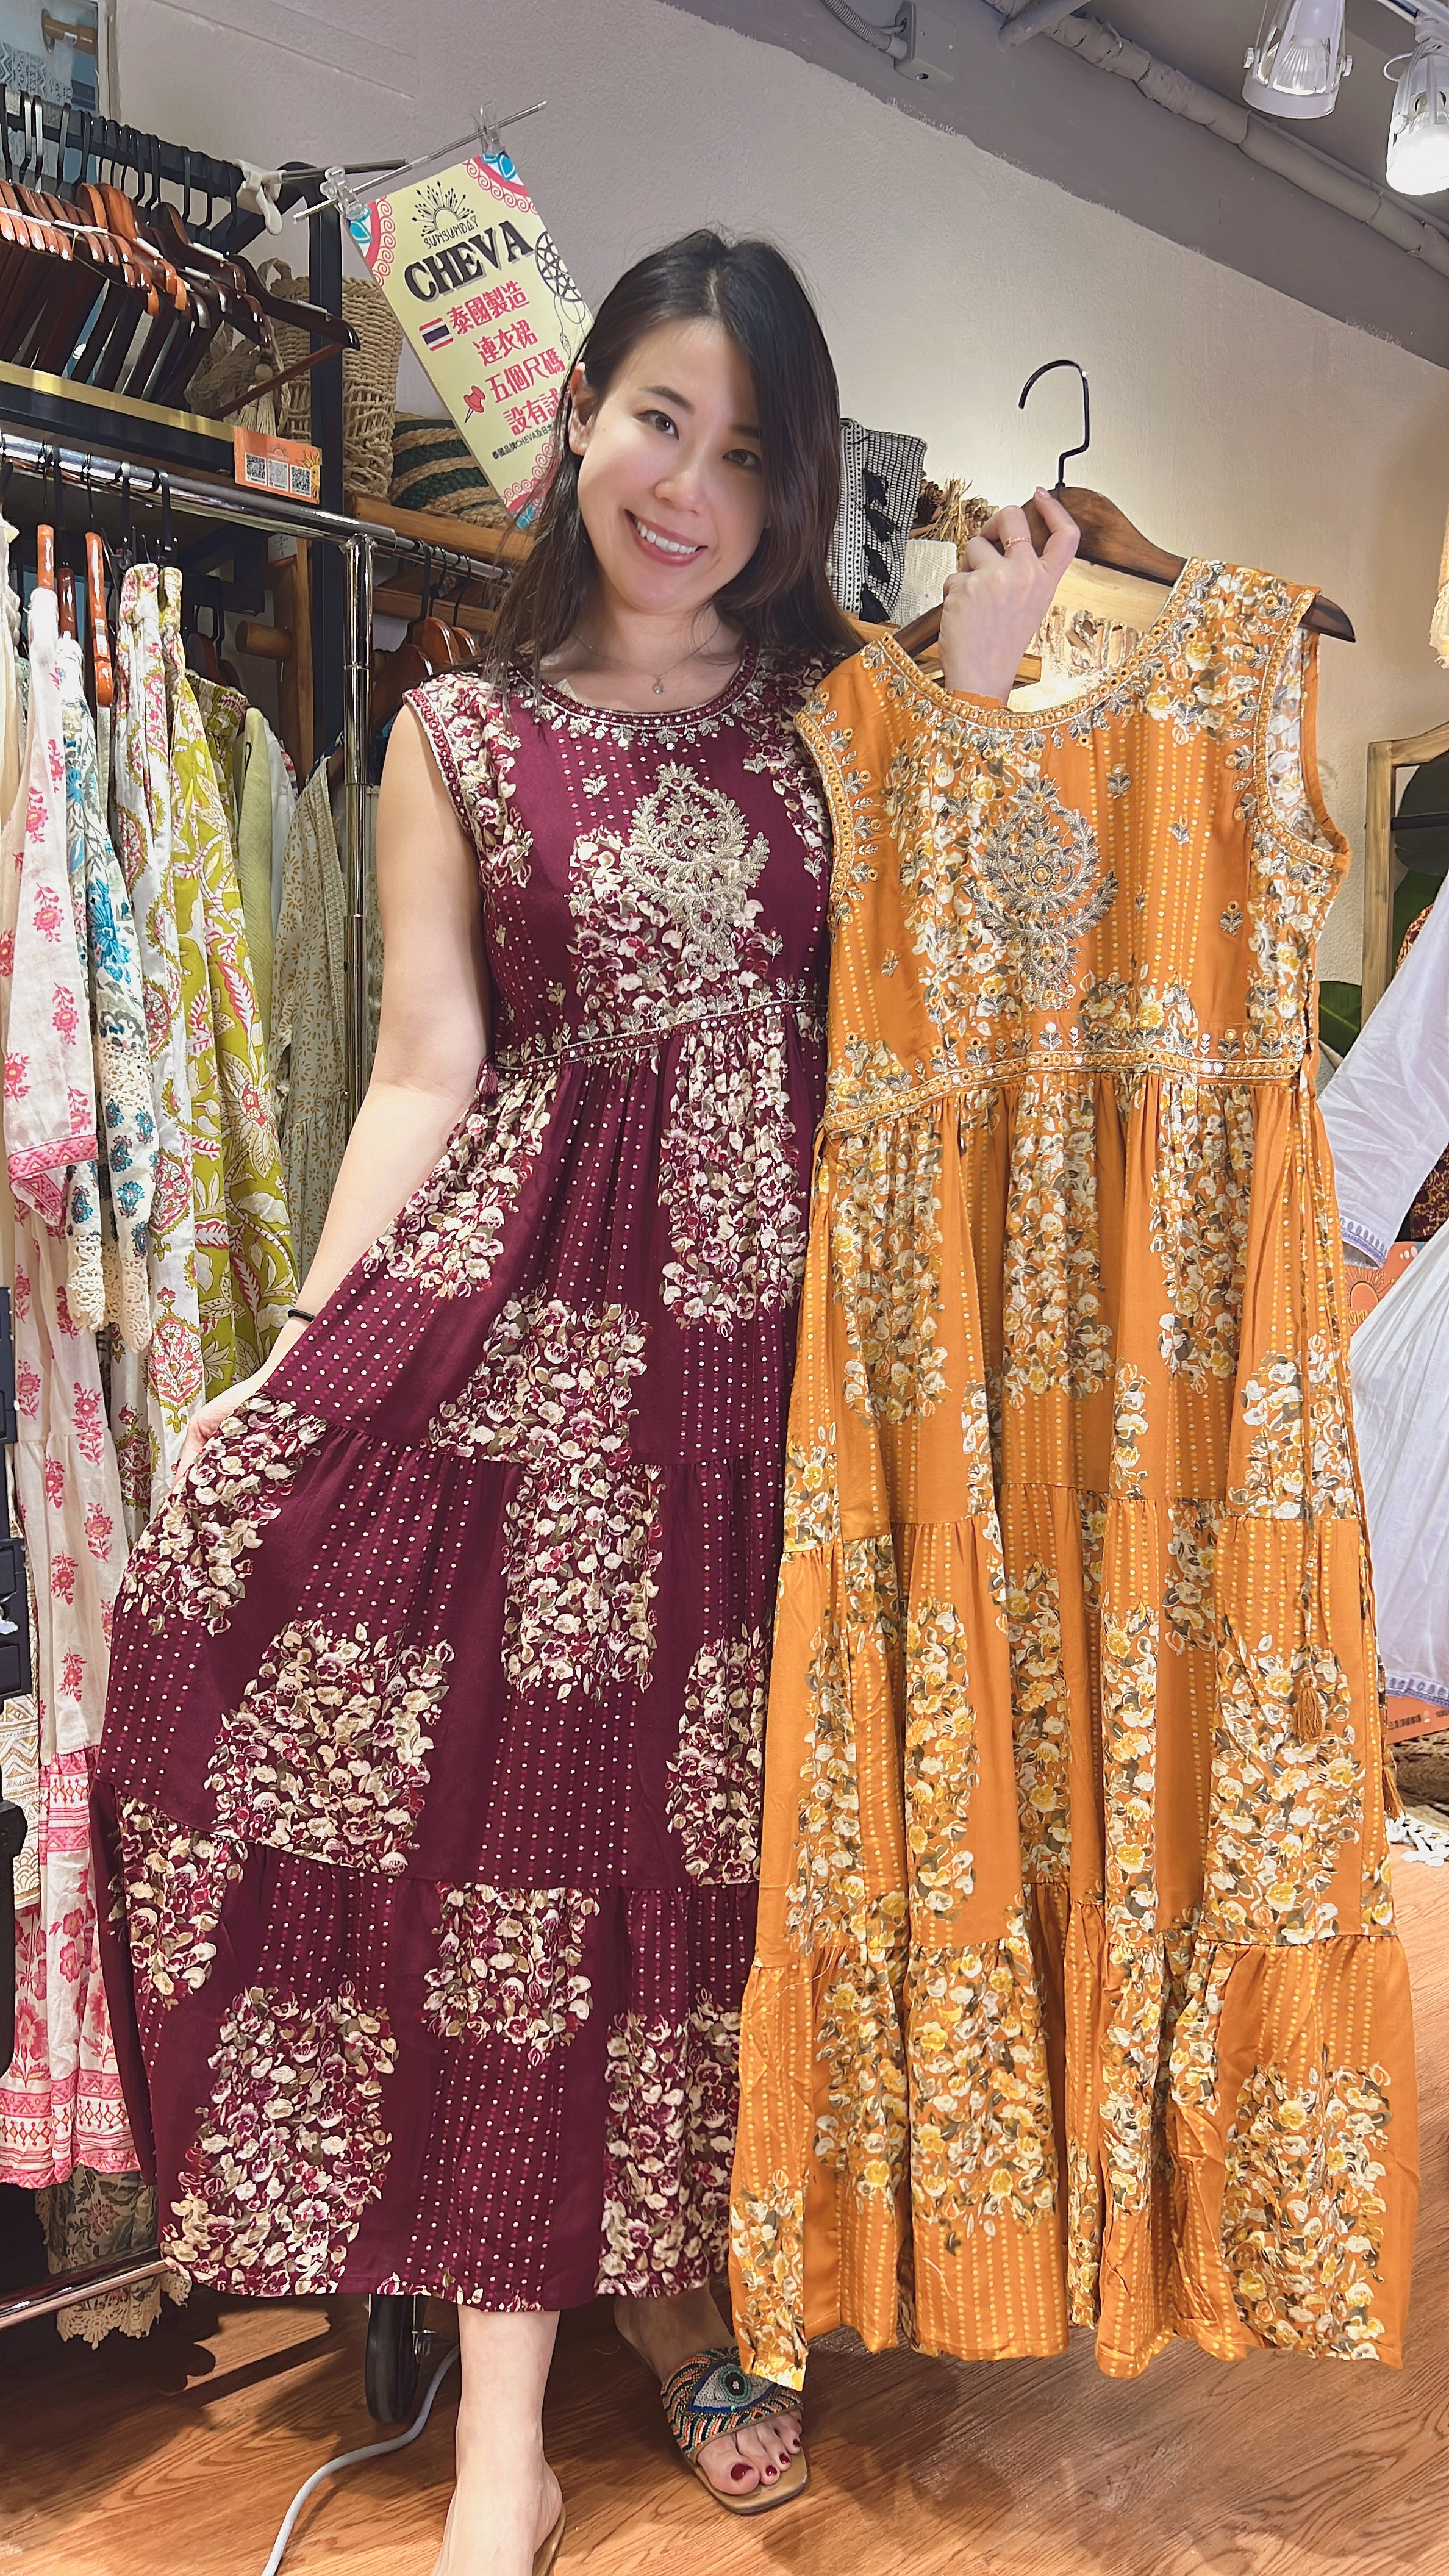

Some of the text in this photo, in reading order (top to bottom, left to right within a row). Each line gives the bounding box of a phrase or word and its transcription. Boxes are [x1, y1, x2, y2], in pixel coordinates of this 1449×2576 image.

[423, 215, 479, 249] SUNSUNDAY
[404, 220, 534, 302] CHEVA
[446, 280, 529, 335] 泰國製造
[472, 319, 538, 366] 連衣裙
[485, 347, 566, 403] 五個尺碼
[503, 388, 568, 435] 設有試
